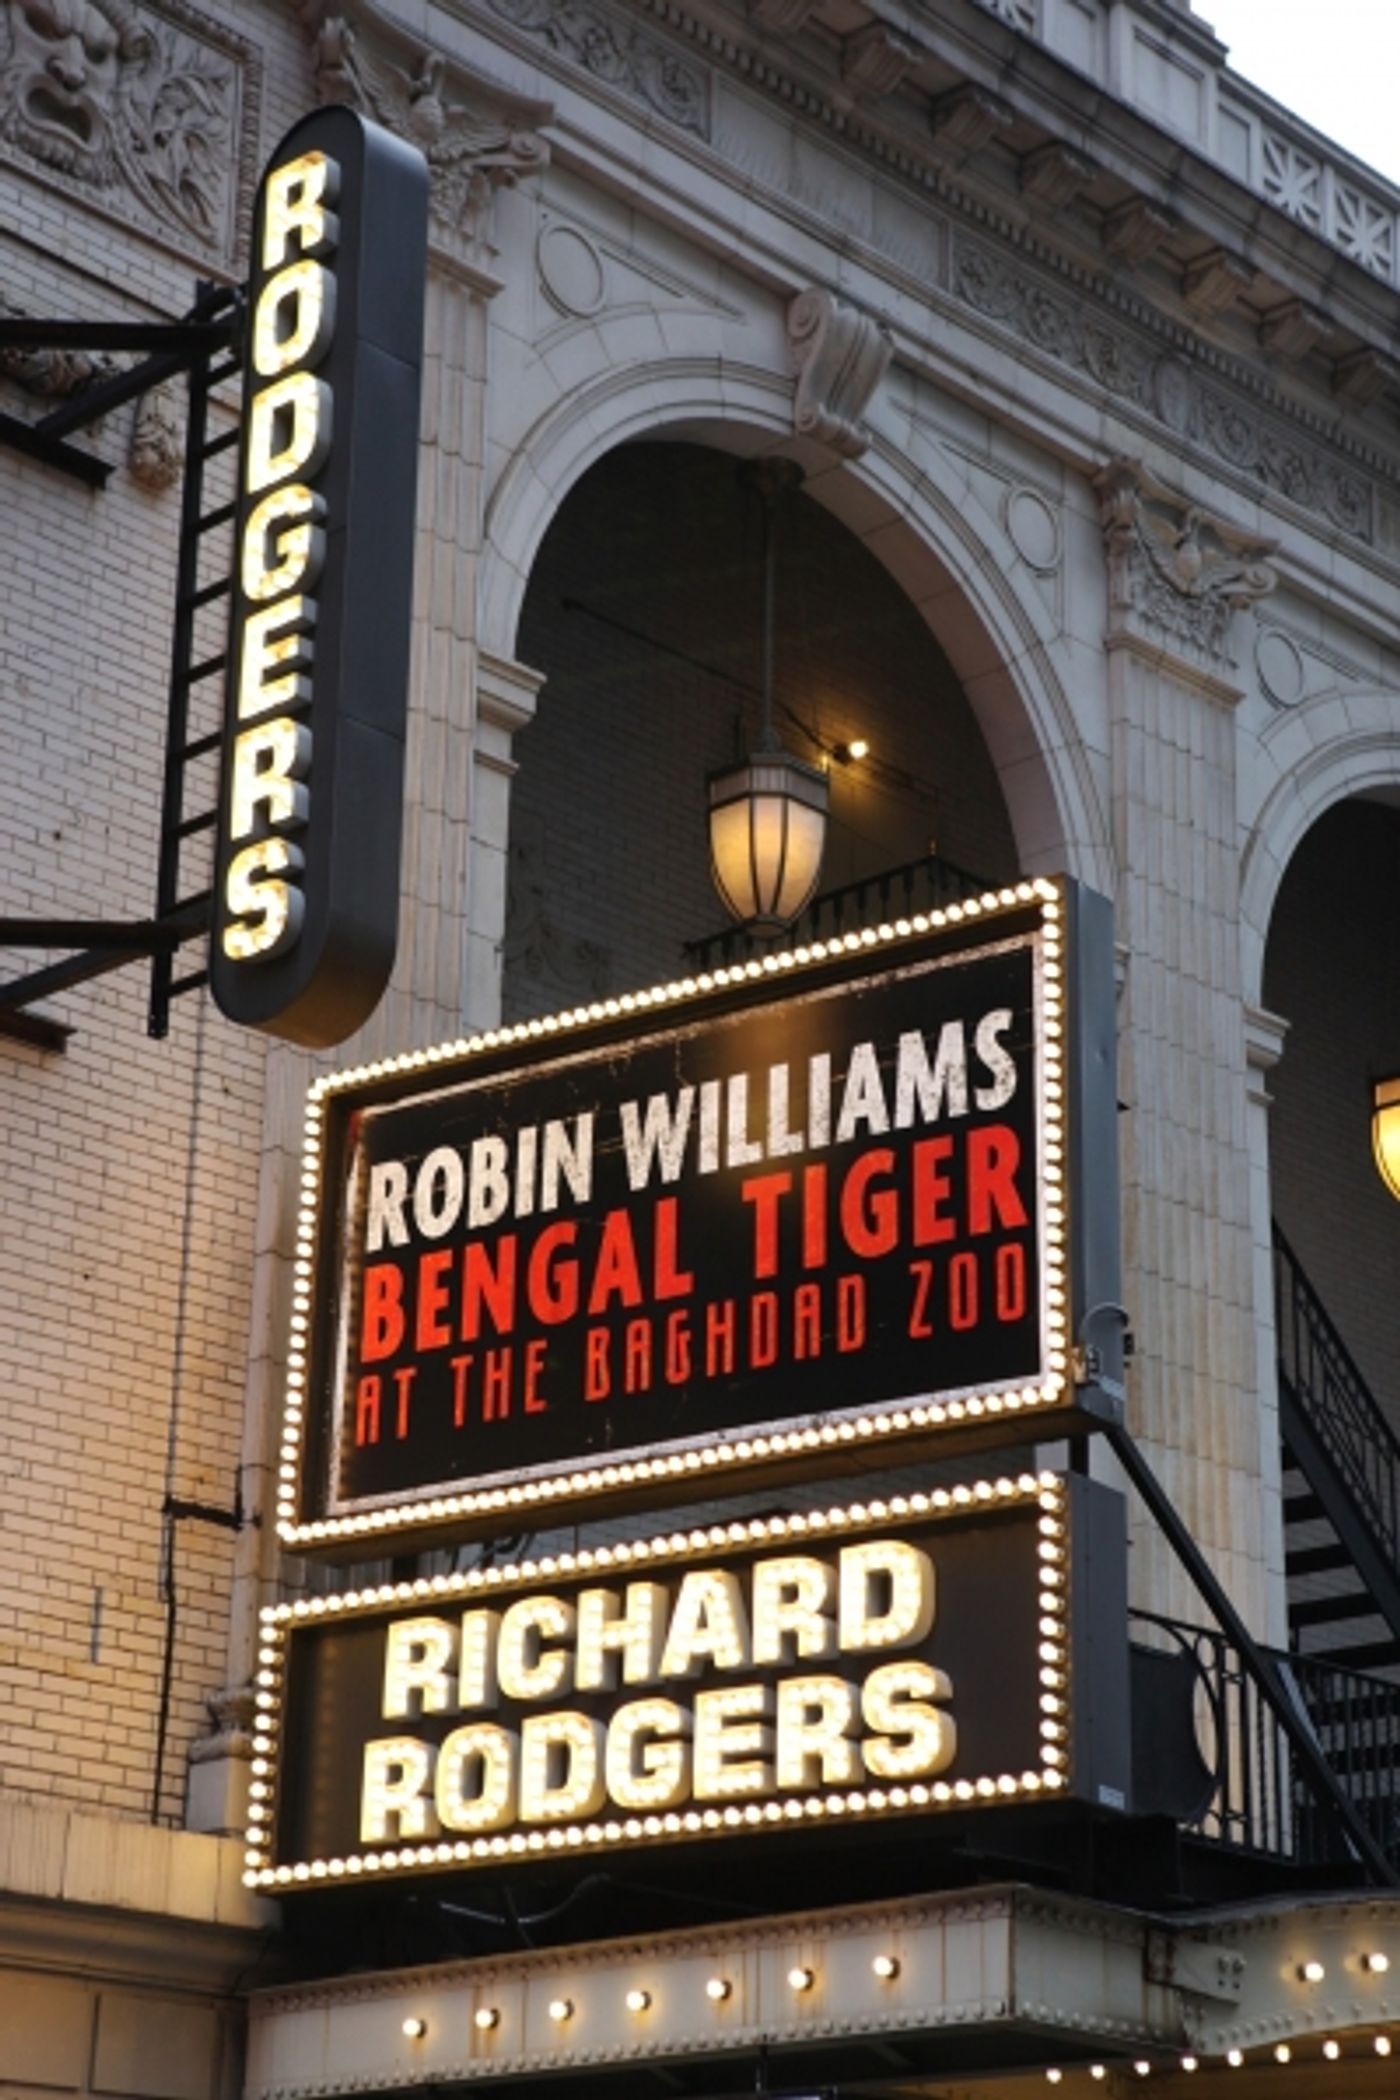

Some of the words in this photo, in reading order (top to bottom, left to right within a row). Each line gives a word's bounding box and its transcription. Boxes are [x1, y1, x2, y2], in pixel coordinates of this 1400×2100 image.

[222, 149, 340, 963] RODGERS
[365, 1110, 593, 1252] ROBIN
[621, 1008, 1017, 1190] WILLIAMS
[354, 1367, 418, 1446] AT
[450, 1341, 548, 1427] THE
[584, 1275, 866, 1399] BAGHDAD
[908, 1243, 1027, 1340] ZOO
[362, 1198, 691, 1364] BENGAL
[742, 1124, 1027, 1277] TIGER
[382, 1540, 936, 1719] RICHARD
[358, 1661, 957, 1845] RODGERS
